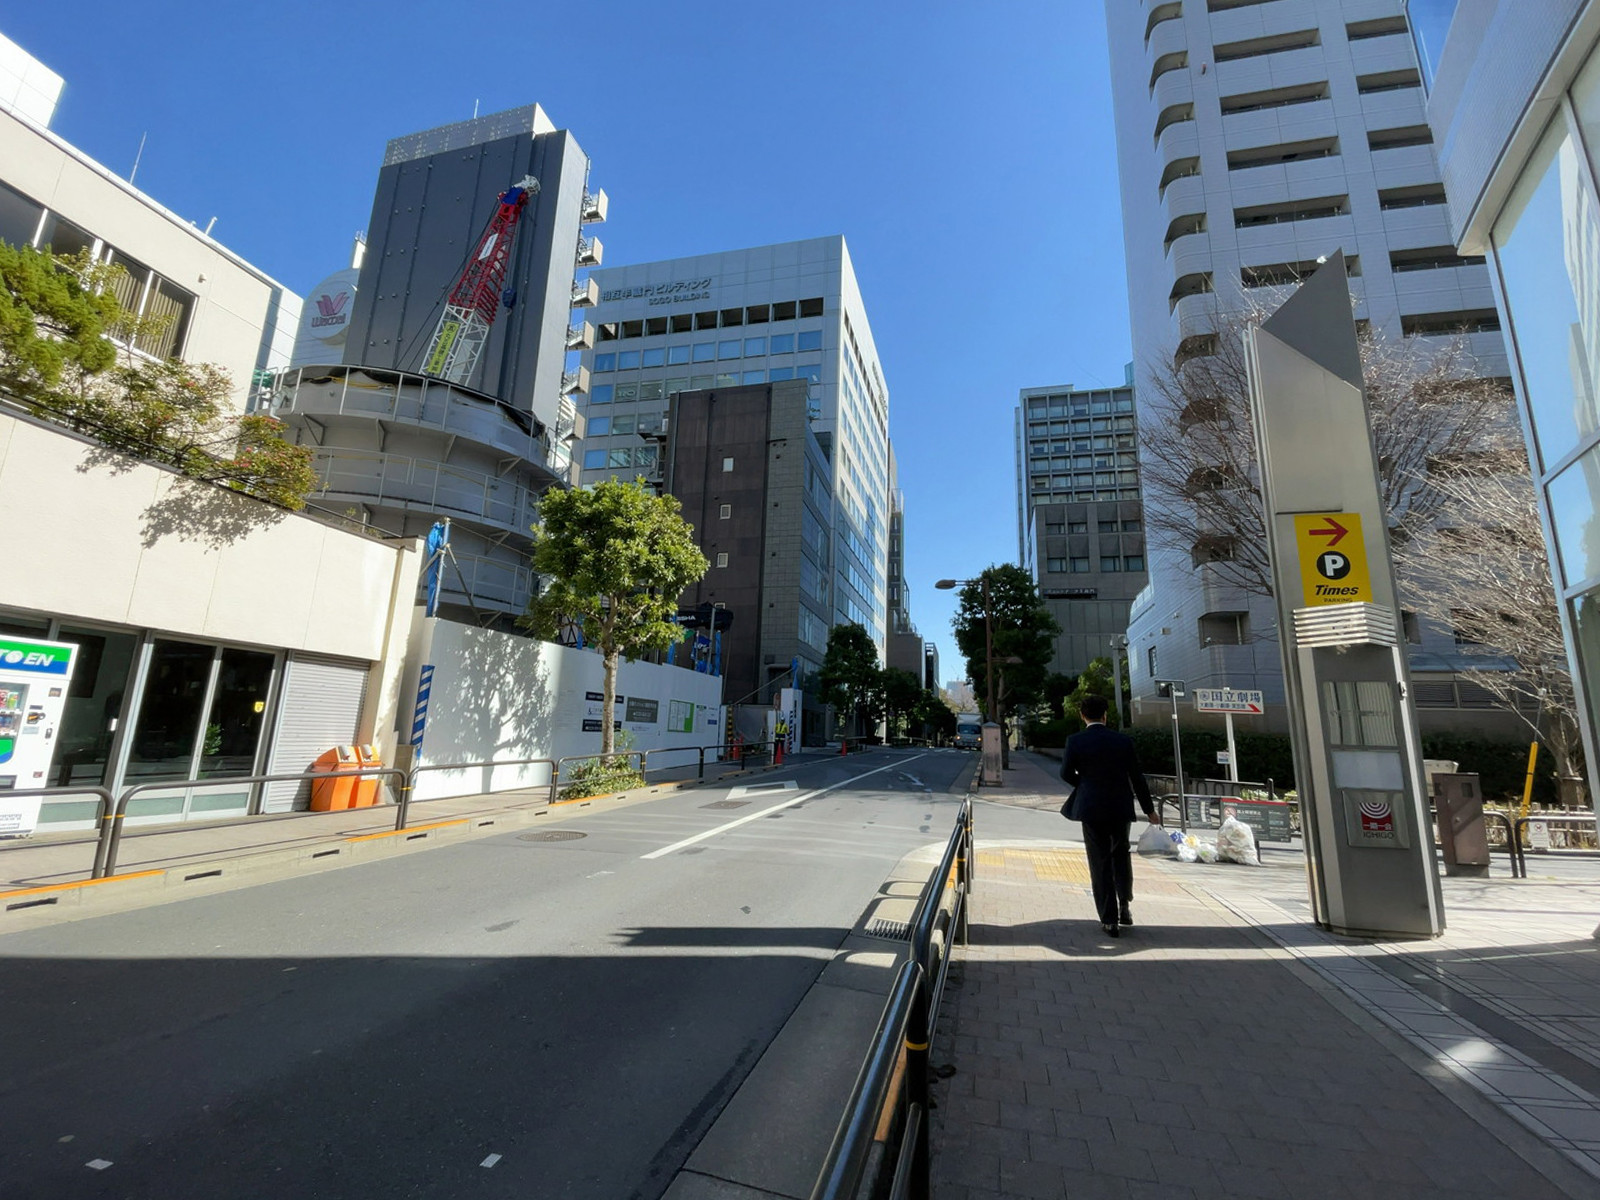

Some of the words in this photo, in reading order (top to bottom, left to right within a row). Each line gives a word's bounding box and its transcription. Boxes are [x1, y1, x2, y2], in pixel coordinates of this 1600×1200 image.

[1324, 554, 1344, 576] P
[1315, 584, 1359, 596] Times
[23, 652, 55, 667] EN
[1211, 690, 1261, 703] 国立劇場
[1363, 831, 1394, 839] ICHIGO
